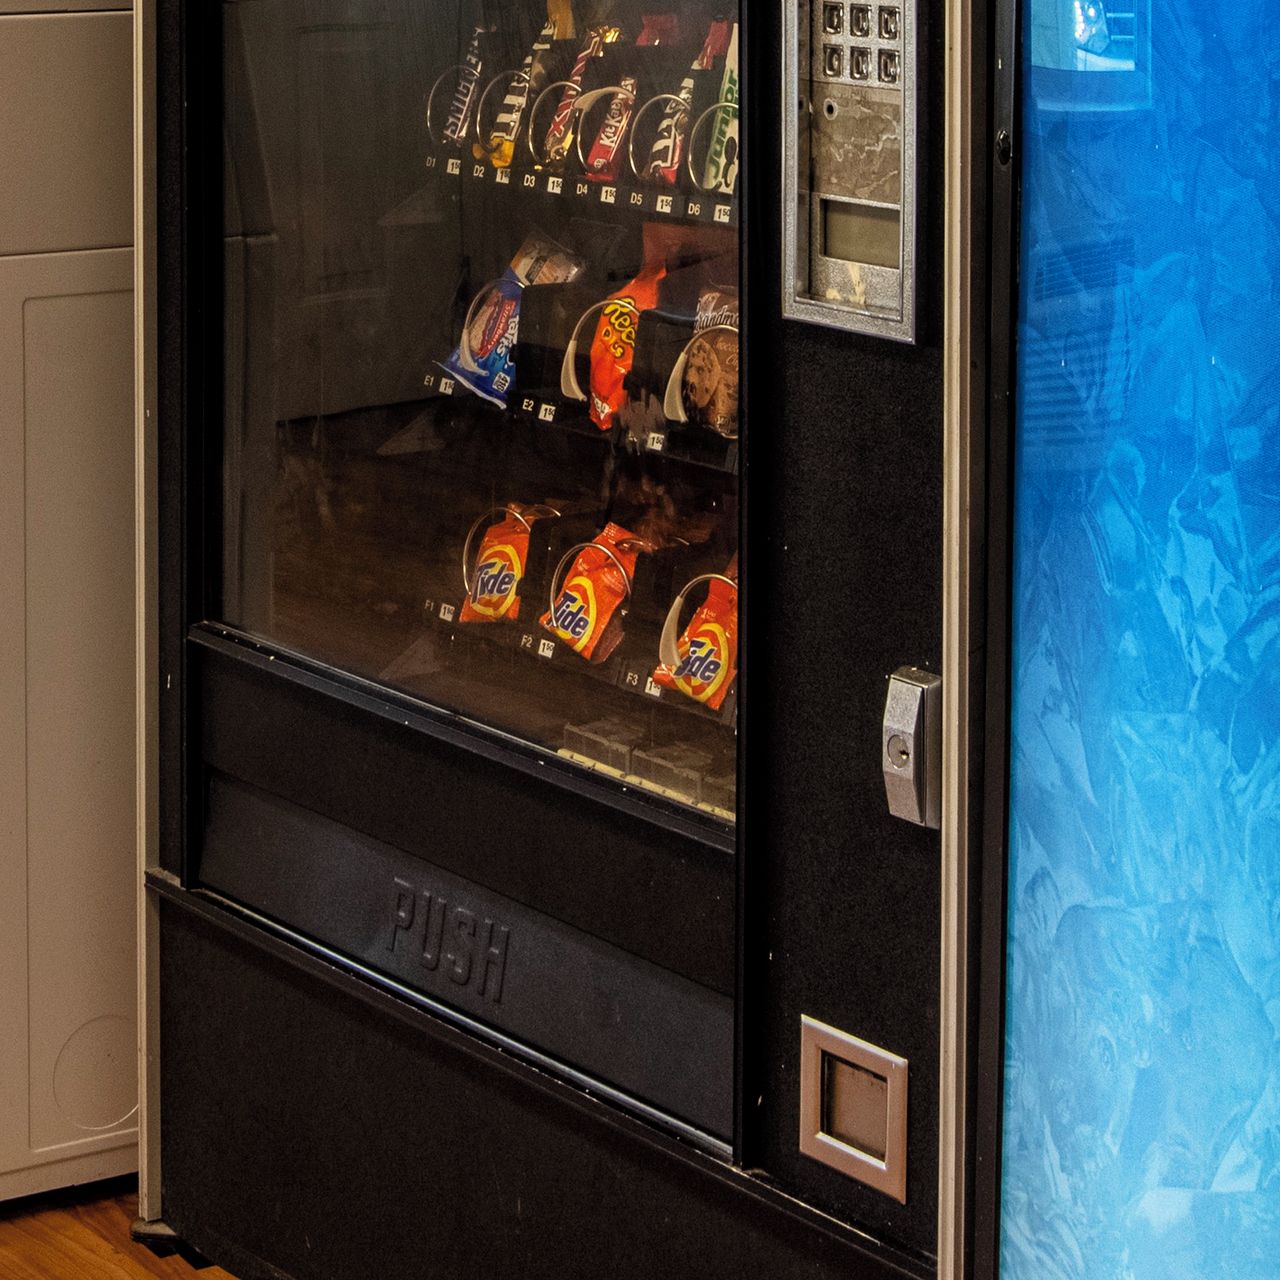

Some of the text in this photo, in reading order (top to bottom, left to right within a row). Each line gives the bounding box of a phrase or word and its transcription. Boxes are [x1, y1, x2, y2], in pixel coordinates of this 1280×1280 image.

[473, 166, 485, 178] D2
[524, 174, 535, 187] D3
[576, 183, 588, 195] D4
[631, 192, 643, 205] D5
[688, 203, 701, 216] D6
[523, 399, 533, 411] E2
[472, 562, 514, 602] Tide
[556, 589, 589, 638] Tide
[522, 635, 532, 648] F2
[675, 639, 721, 683] Tide
[626, 672, 638, 686] F3
[387, 876, 510, 1004] PUSH
